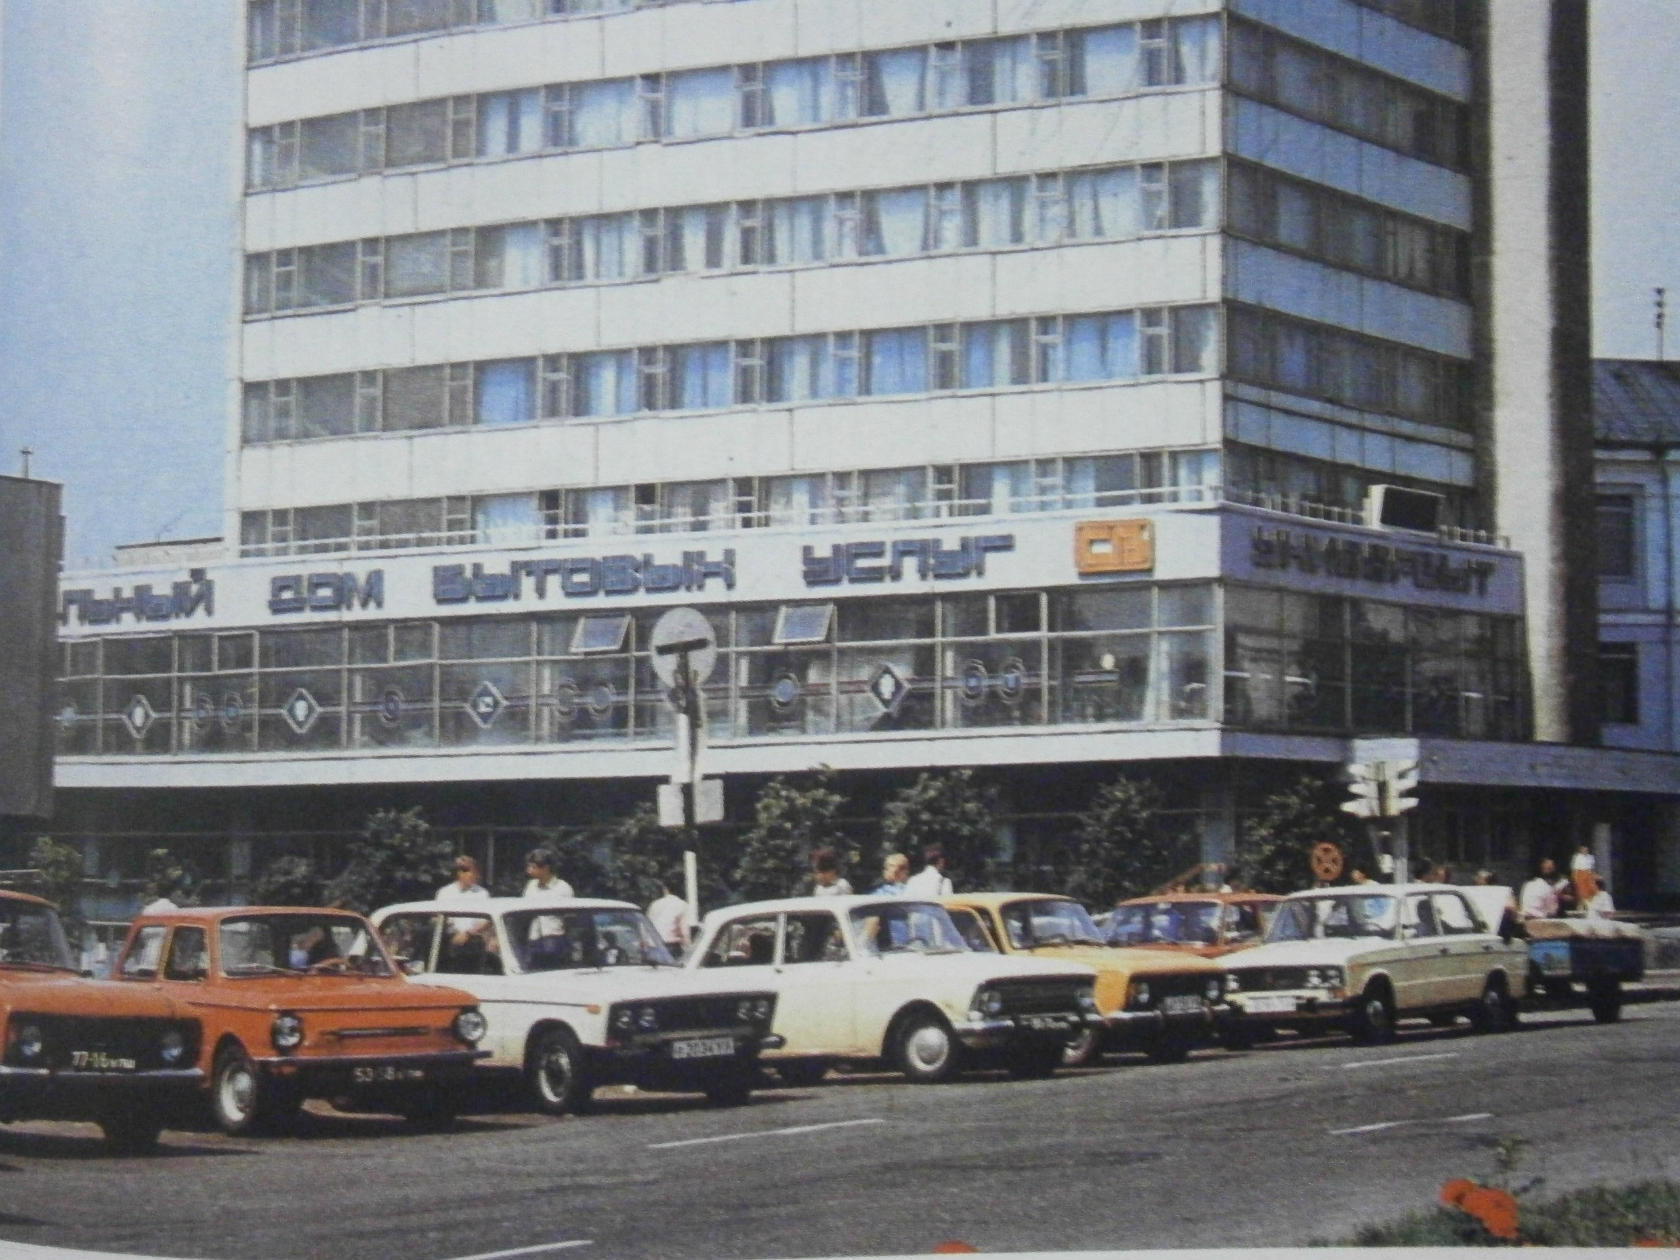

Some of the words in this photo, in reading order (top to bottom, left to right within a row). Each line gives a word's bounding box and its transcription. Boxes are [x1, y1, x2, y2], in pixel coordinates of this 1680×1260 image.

[268, 568, 385, 615] ДОМ
[433, 549, 736, 604] БЫТОВЫХ
[802, 534, 1015, 587] УСЛУГ
